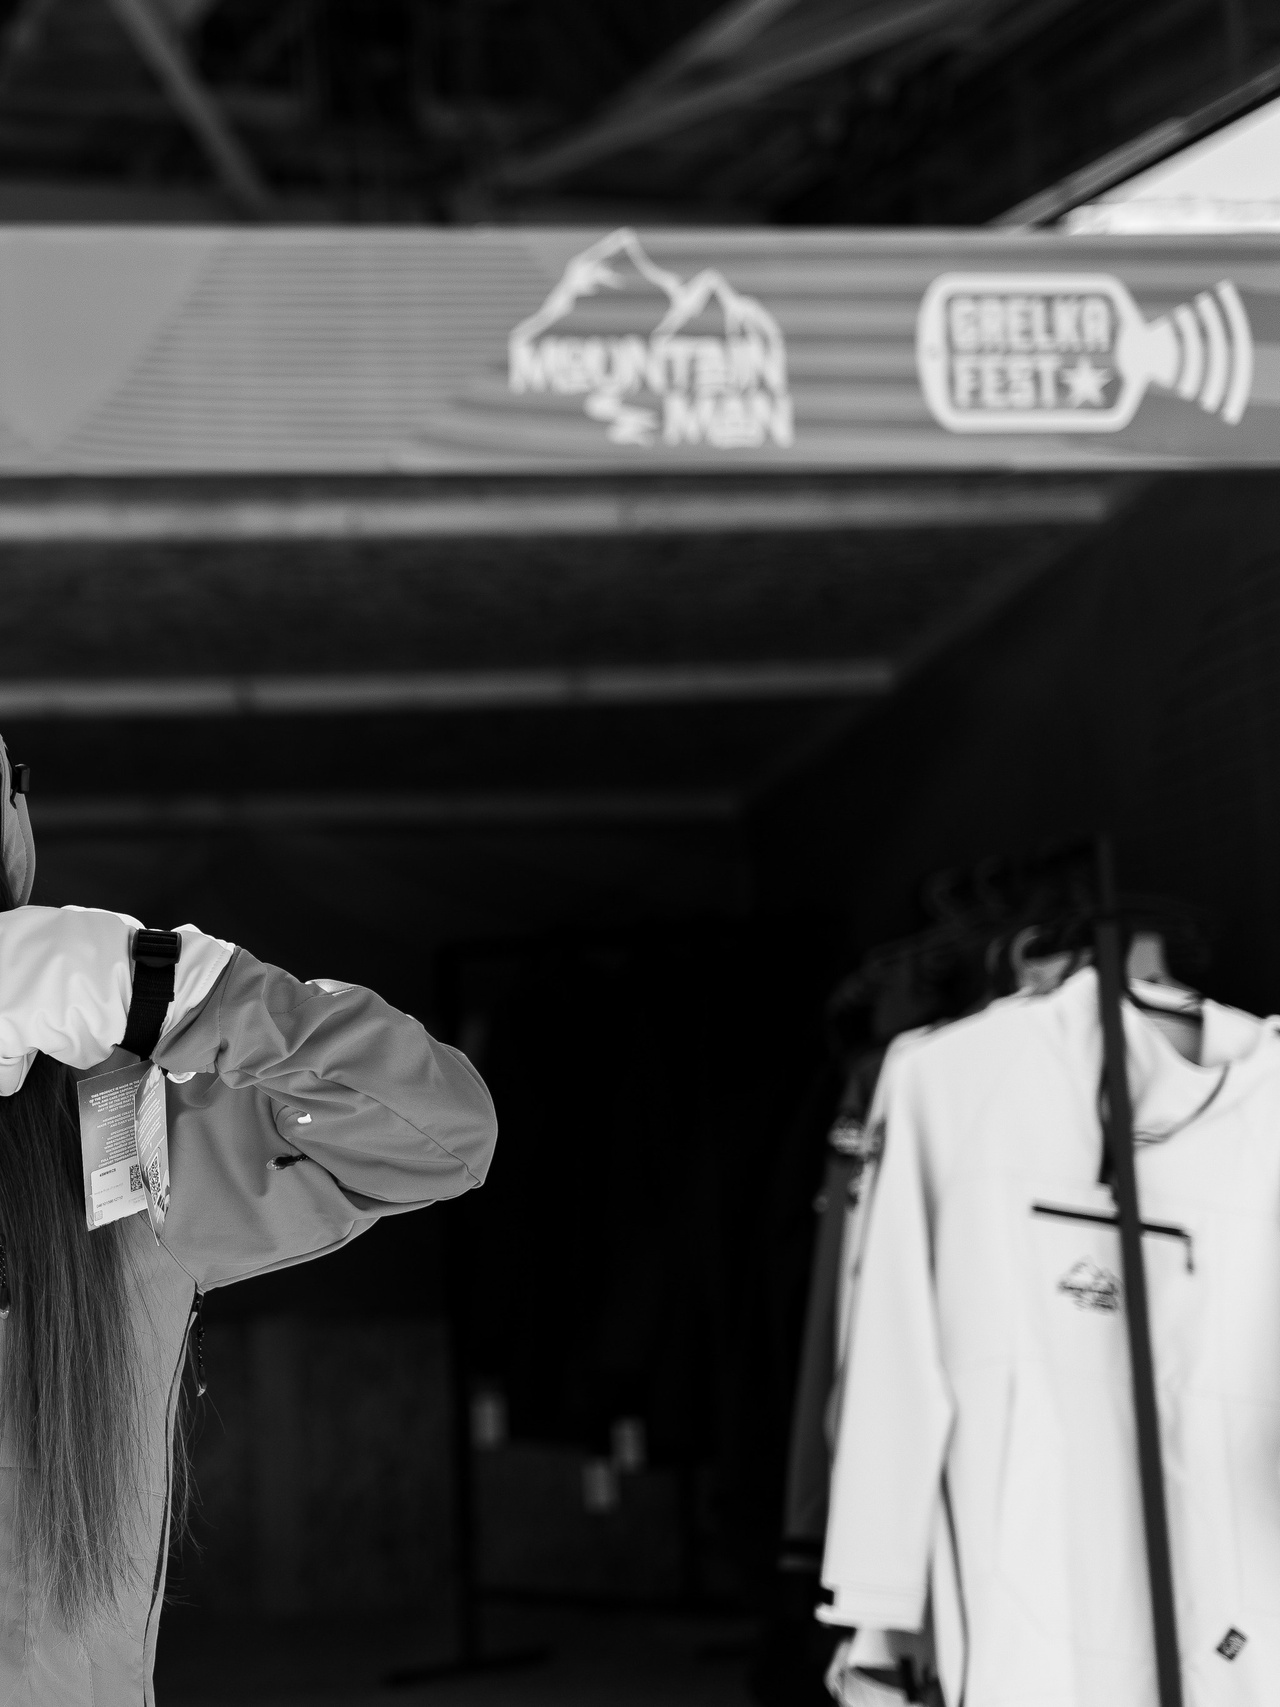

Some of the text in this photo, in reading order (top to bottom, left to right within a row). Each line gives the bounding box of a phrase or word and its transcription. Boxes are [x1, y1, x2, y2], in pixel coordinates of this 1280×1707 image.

[509, 336, 787, 395] MOUNTAIN
[952, 352, 1062, 409] FEST
[663, 393, 795, 449] MAN
